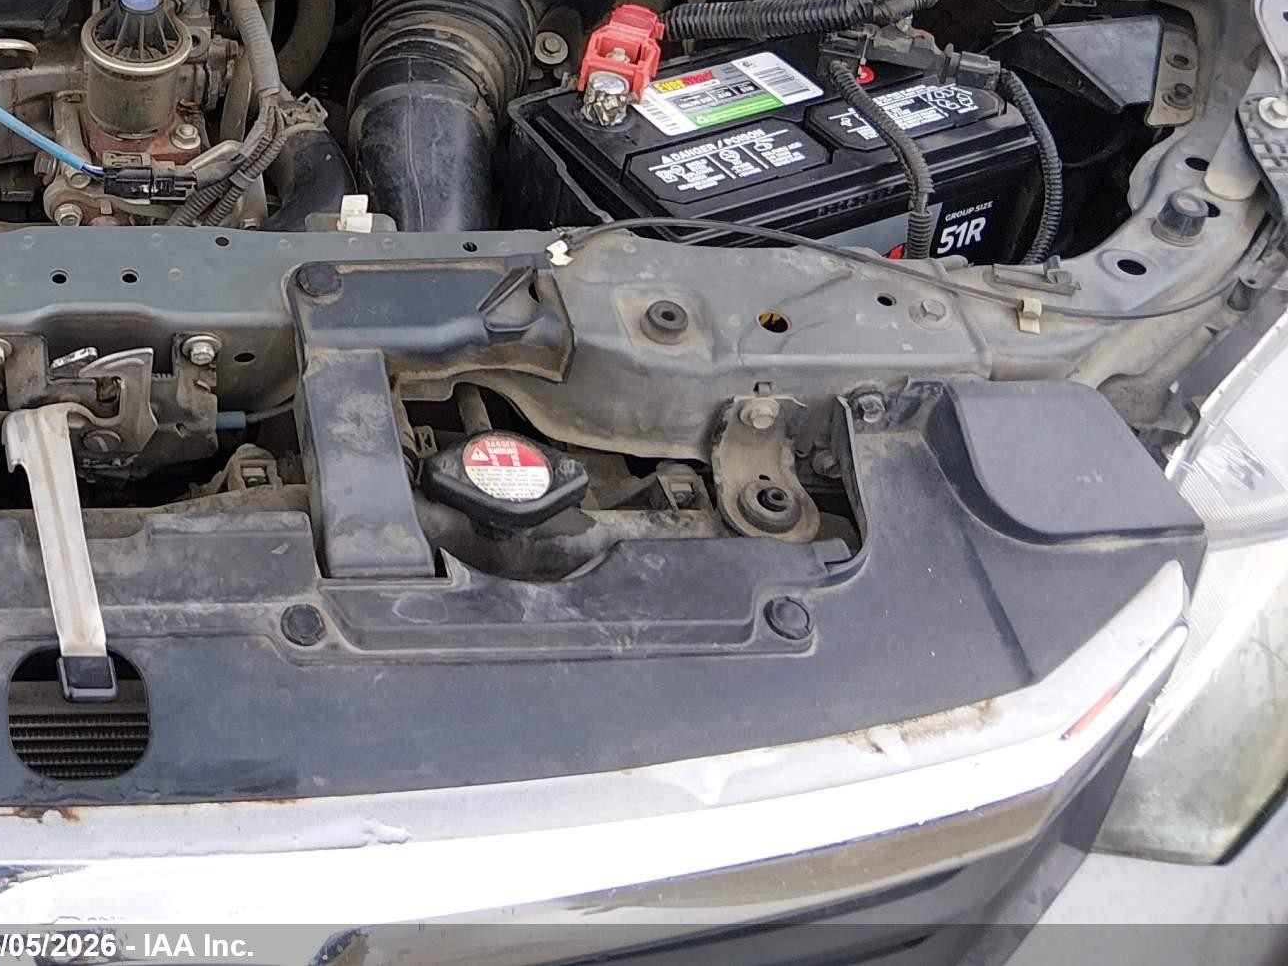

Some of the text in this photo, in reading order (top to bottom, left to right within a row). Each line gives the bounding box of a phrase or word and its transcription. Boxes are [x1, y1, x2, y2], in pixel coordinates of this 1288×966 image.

[669, 143, 715, 162] DANGER
[725, 128, 767, 146] POISON
[944, 199, 994, 223] GROUP SIZE
[936, 216, 987, 255] 51R
